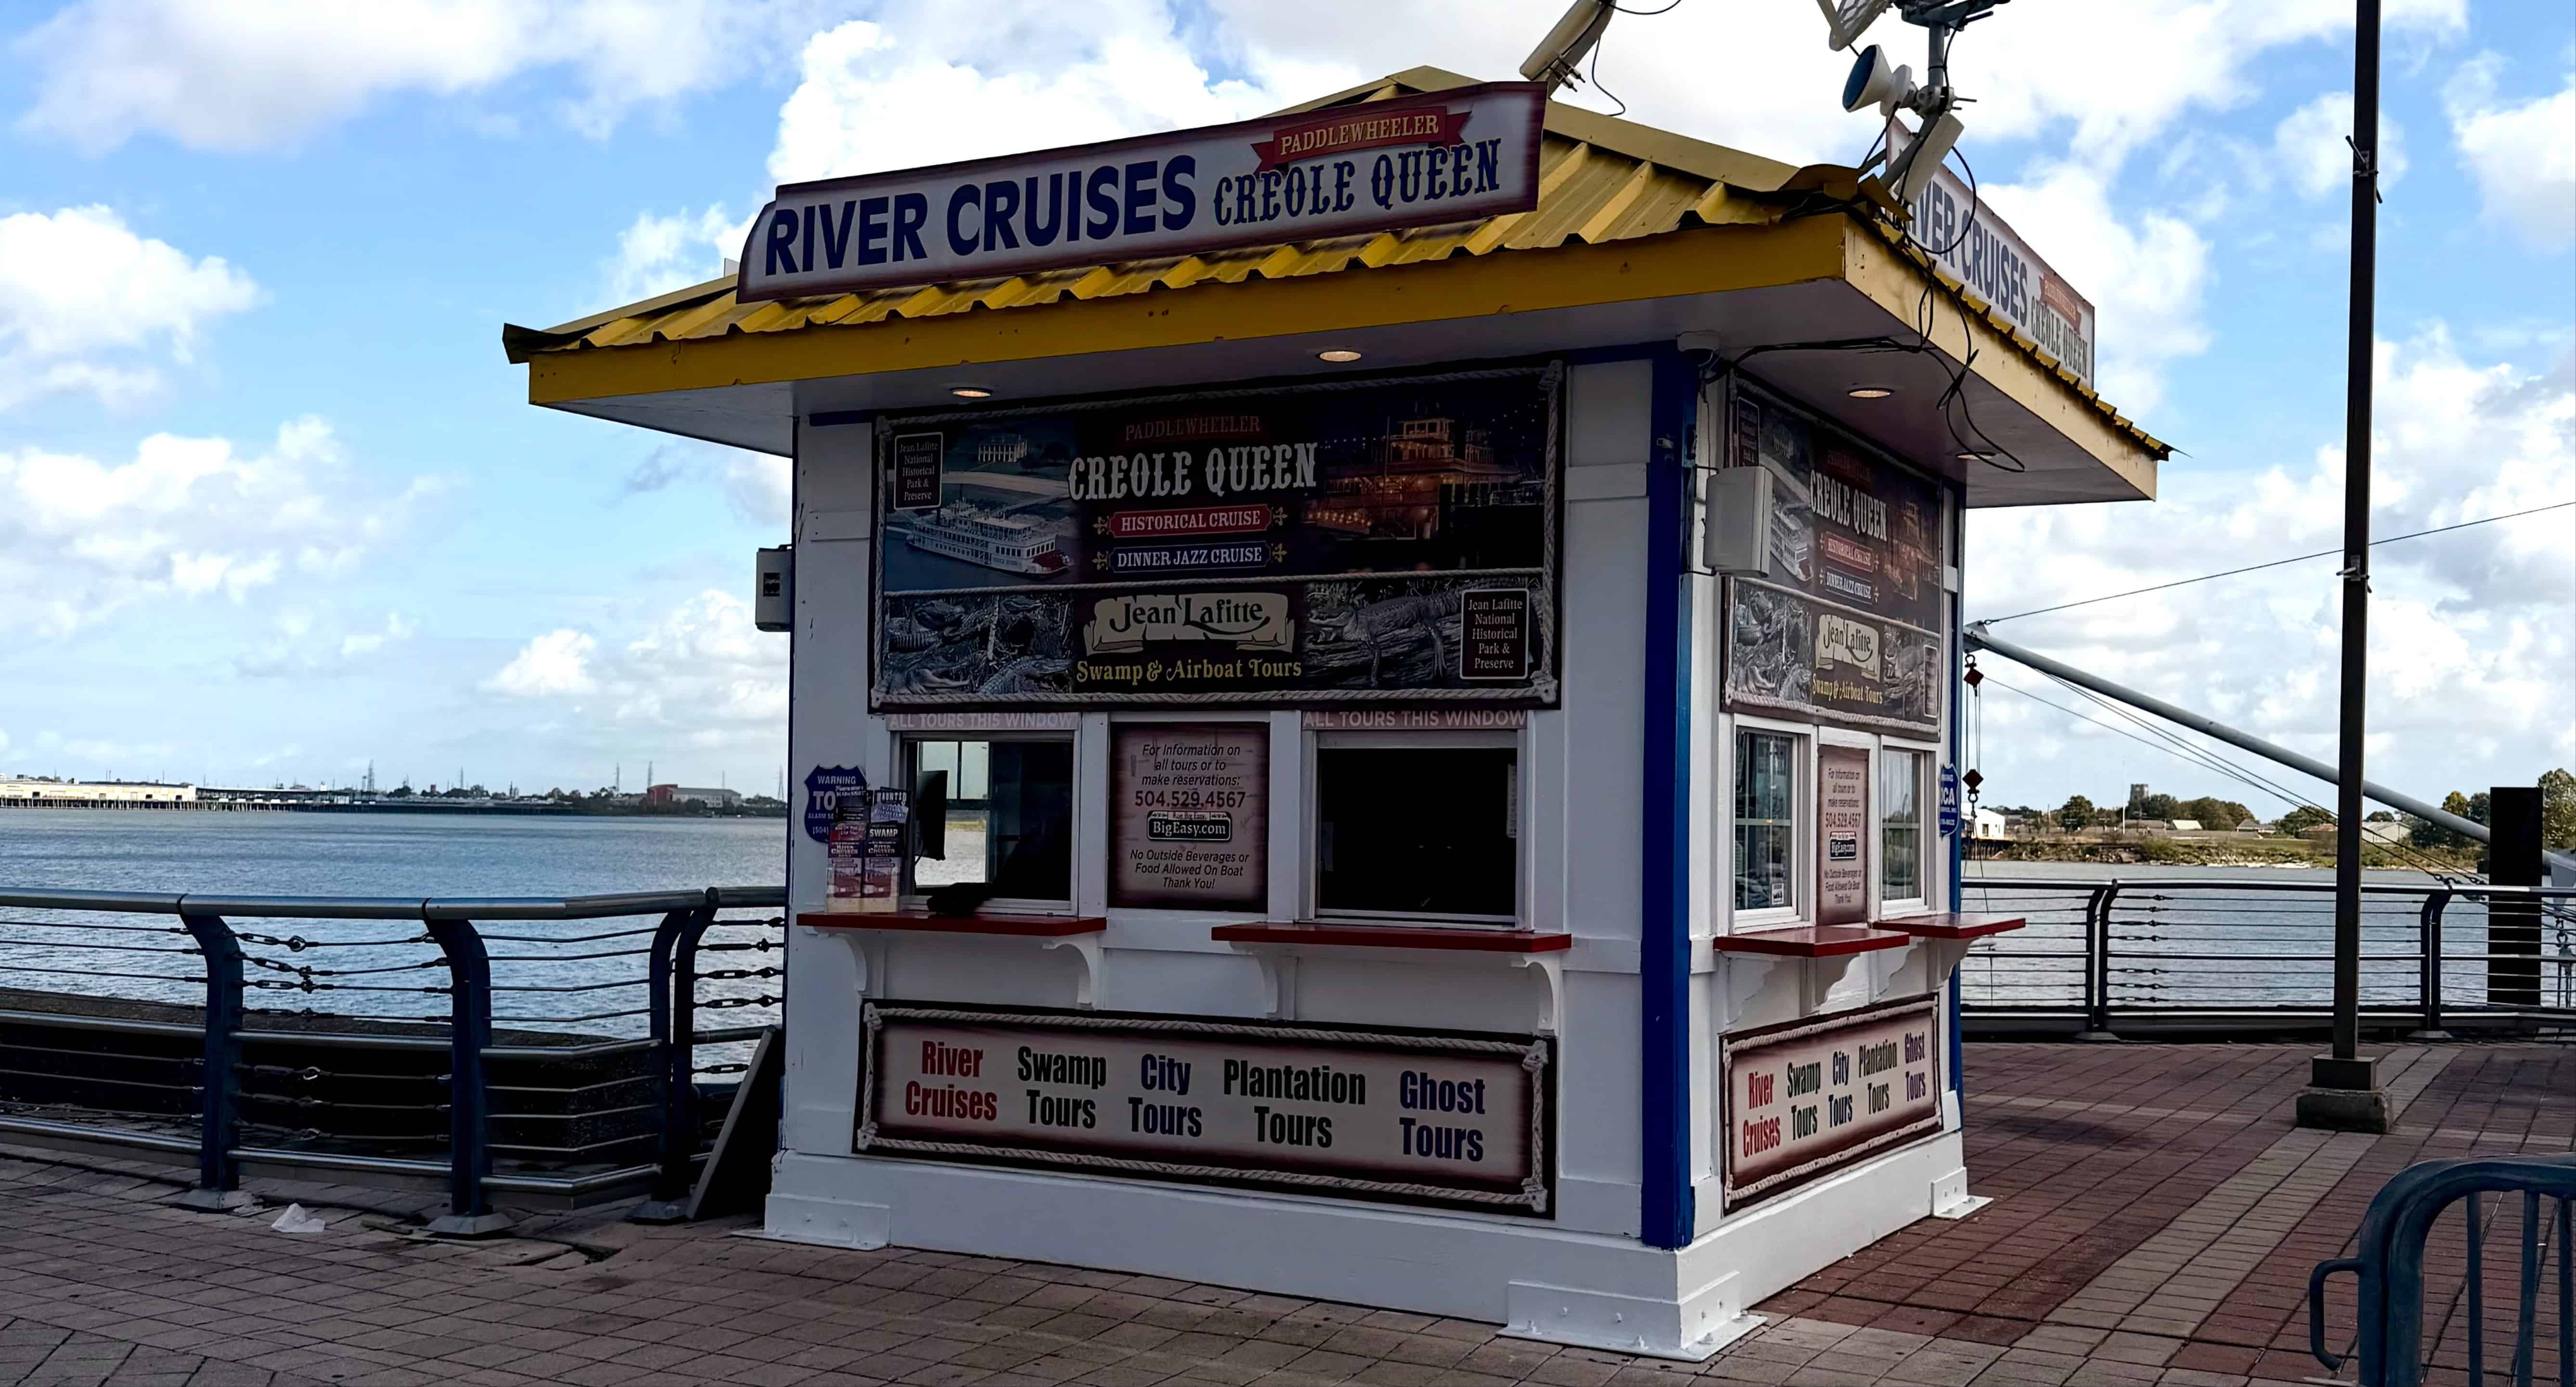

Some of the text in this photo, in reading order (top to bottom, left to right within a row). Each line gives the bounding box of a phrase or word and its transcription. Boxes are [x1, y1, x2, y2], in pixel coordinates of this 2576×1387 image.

[1280, 115, 1439, 155] PADDLEWHEELER
[1214, 138, 1501, 226] CREOLE QUEEN
[765, 155, 1196, 276] RIVER CRUISES
[1961, 209, 2027, 327] CRUISES
[2031, 295, 2088, 379] CREOLE QUEEN
[1125, 415, 1261, 441] PADDLEWHEELER
[902, 465, 935, 477] Historical
[904, 453, 934, 465] National
[1068, 442, 1318, 501] CREOLE QUEEN
[904, 491, 932, 501] Preserve
[907, 478, 922, 488] Park
[1121, 510, 1261, 531] HISTORICAL CRUISE
[1810, 469, 1887, 541] CREOLE QUEEN
[1117, 546, 1262, 567] DINNER JAZZ CRUISE
[1109, 598, 1270, 634] Jean Lafitte
[1468, 598, 1523, 611] Jean Lafitte
[1474, 612, 1515, 625] National
[1472, 628, 1517, 640] Historical
[1478, 642, 1510, 654] Park &
[1823, 621, 1873, 662] Jean Lafitte
[1077, 658, 1302, 686] Swamp & Airboat Tours
[1474, 657, 1514, 669] Preserve
[1813, 673, 1833, 701] Swamp
[1840, 681, 1863, 701] Airboat
[1865, 685, 1883, 704] Tours
[889, 712, 1073, 728] ALL TOURS THIS WINDOW
[1302, 709, 1526, 727] ALL TOURS THIS WINDOW
[1142, 744, 1241, 756] For Information on
[1155, 759, 1226, 771] all tours or to
[818, 775, 856, 785] WARNING
[1142, 775, 1240, 785] make reservations:
[813, 791, 836, 810] TO
[1135, 791, 1245, 808] 504.529.4567
[1941, 787, 1955, 805] CA
[870, 828, 898, 837] SWAMP
[1153, 821, 1226, 837] BigEasy.com
[1130, 849, 1249, 863] No Outside Beverages or
[1135, 863, 1243, 876] Food Allowed On Boat
[1163, 877, 1215, 889] Thank You!
[923, 1041, 983, 1077] River
[1859, 1039, 1897, 1078] Plantation
[1905, 1032, 1925, 1064] Ghost
[1018, 1046, 1106, 1089] Swamp
[1141, 1054, 1192, 1095] City
[1224, 1059, 1366, 1104] Plantation
[1787, 1062, 1821, 1098] Swamp
[1833, 1052, 1849, 1086] City
[906, 1081, 997, 1121] Cruises
[1400, 1070, 1486, 1114] Ghost
[1749, 1071, 1774, 1109] River
[1868, 1082, 1889, 1115] Tours
[1905, 1071, 1925, 1102] Tours
[1026, 1090, 1096, 1129] Tours
[1128, 1097, 1202, 1137] Tours
[1791, 1105, 1818, 1140] Tours
[1828, 1094, 1852, 1128] Tours
[1254, 1106, 1333, 1148] Tours
[1399, 1117, 1484, 1162] Tours
[1743, 1116, 1781, 1157] Cruises
